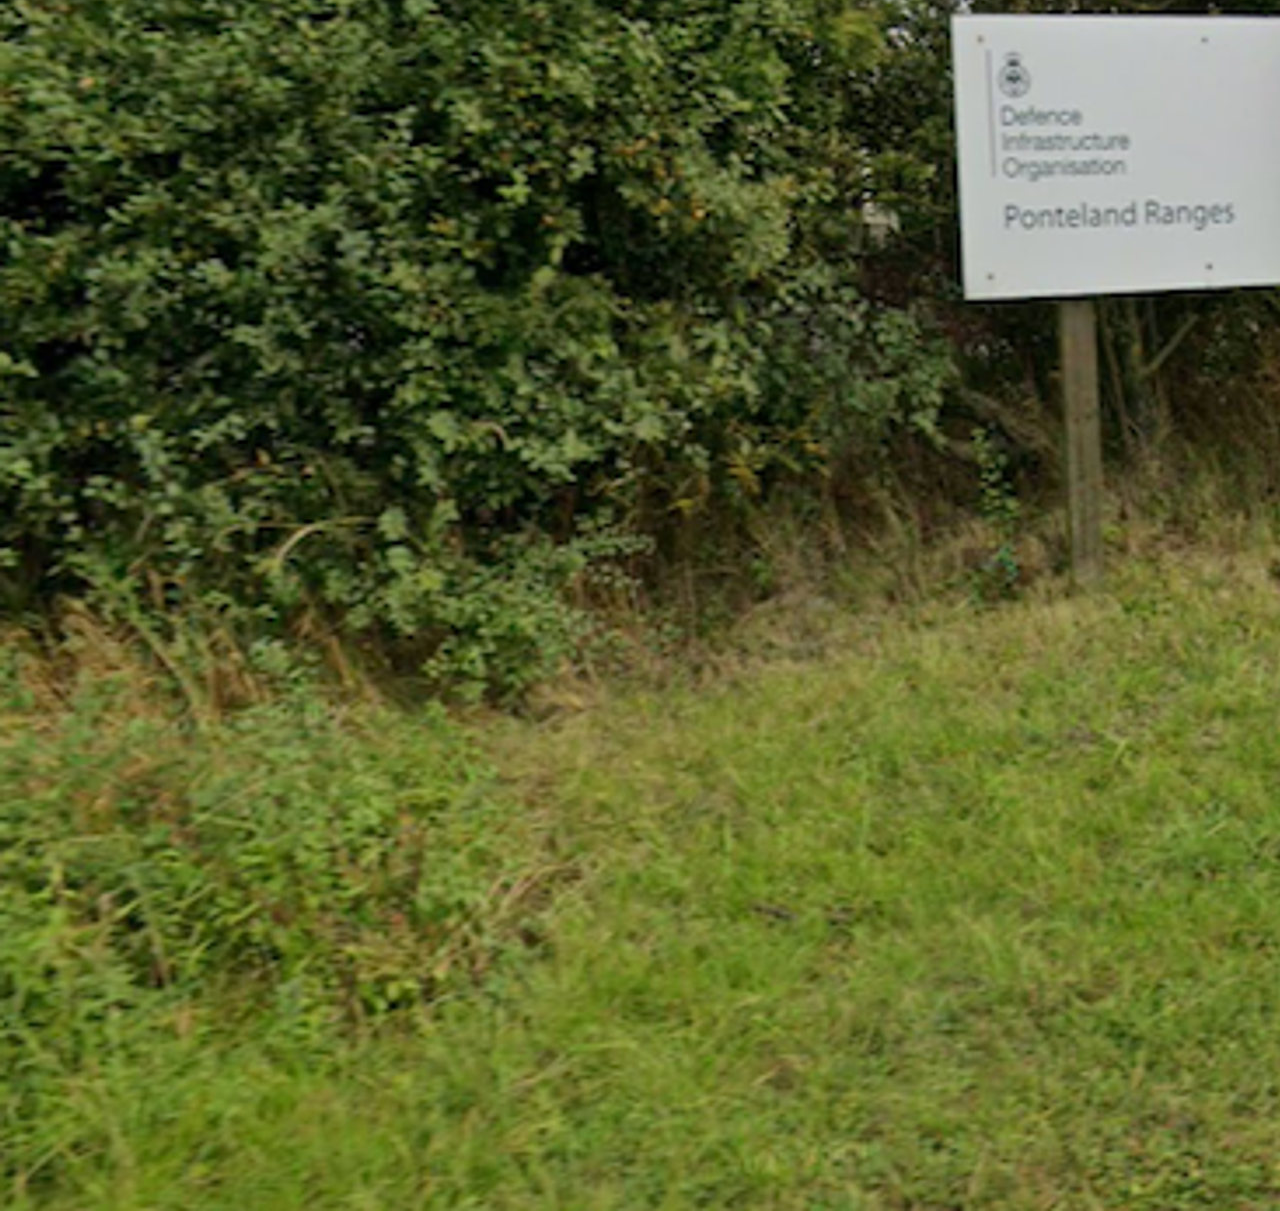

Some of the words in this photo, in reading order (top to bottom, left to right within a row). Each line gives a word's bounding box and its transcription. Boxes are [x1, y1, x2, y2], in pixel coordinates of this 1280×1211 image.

[1001, 104, 1082, 127] Defence
[1002, 131, 1129, 151] Infrastructure
[1002, 157, 1126, 182] Organisation
[1004, 201, 1137, 229] Ponteland
[1145, 199, 1235, 230] Ranges
